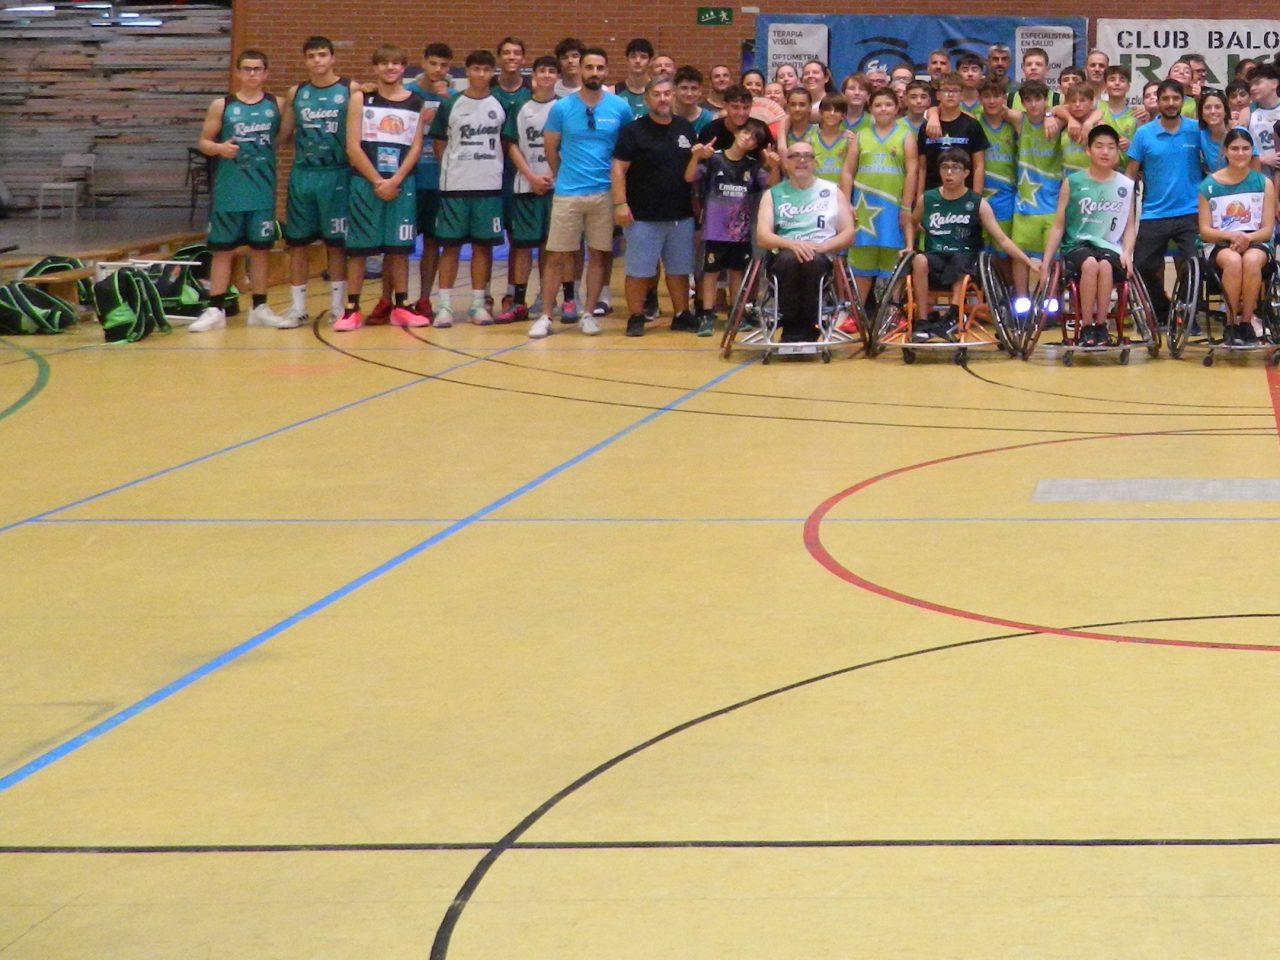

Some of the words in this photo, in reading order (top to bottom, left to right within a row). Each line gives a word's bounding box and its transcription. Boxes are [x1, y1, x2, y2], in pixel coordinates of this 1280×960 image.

[1117, 31, 1190, 49] CLUB
[817, 215, 825, 229] 6
[1110, 217, 1118, 231] 6
